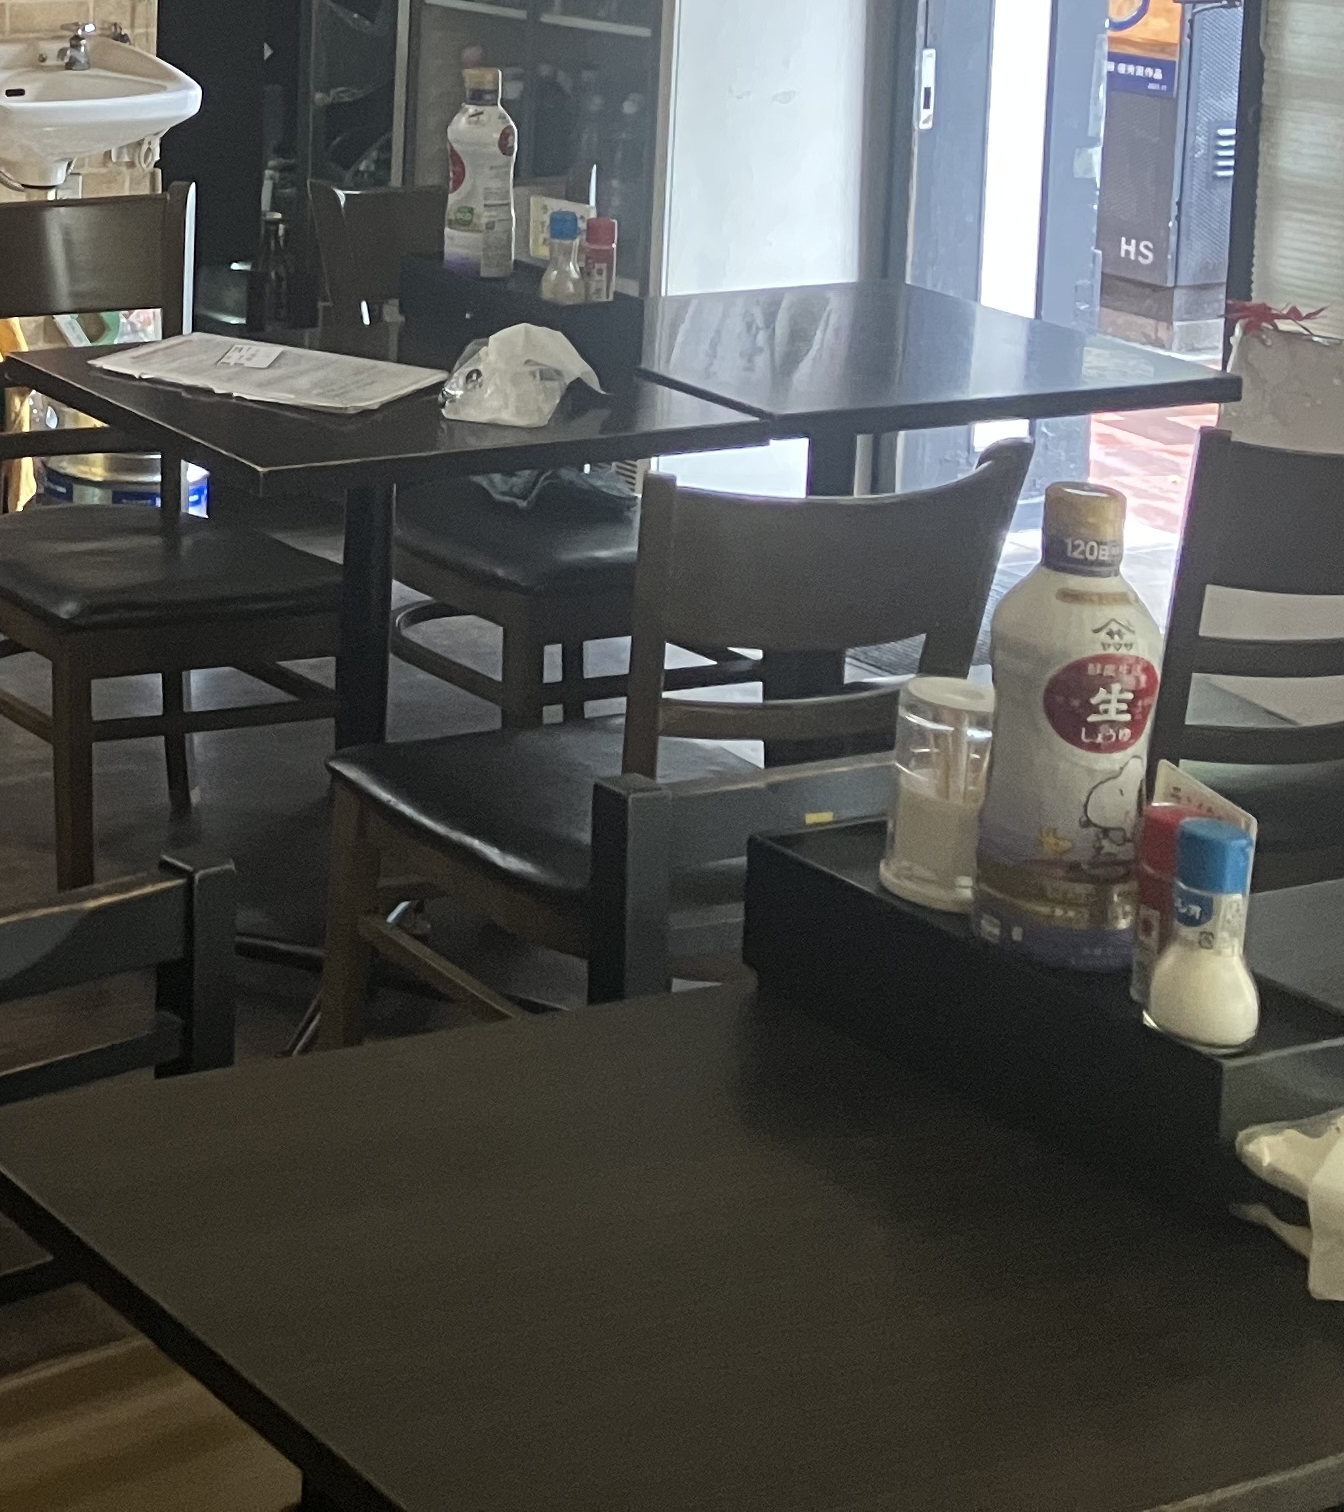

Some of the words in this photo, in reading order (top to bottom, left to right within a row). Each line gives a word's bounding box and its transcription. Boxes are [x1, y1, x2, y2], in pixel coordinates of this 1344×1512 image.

[1119, 236, 1155, 265] HS
[1086, 683, 1134, 723] 生
[1080, 726, 1132, 744] しょうゆ
